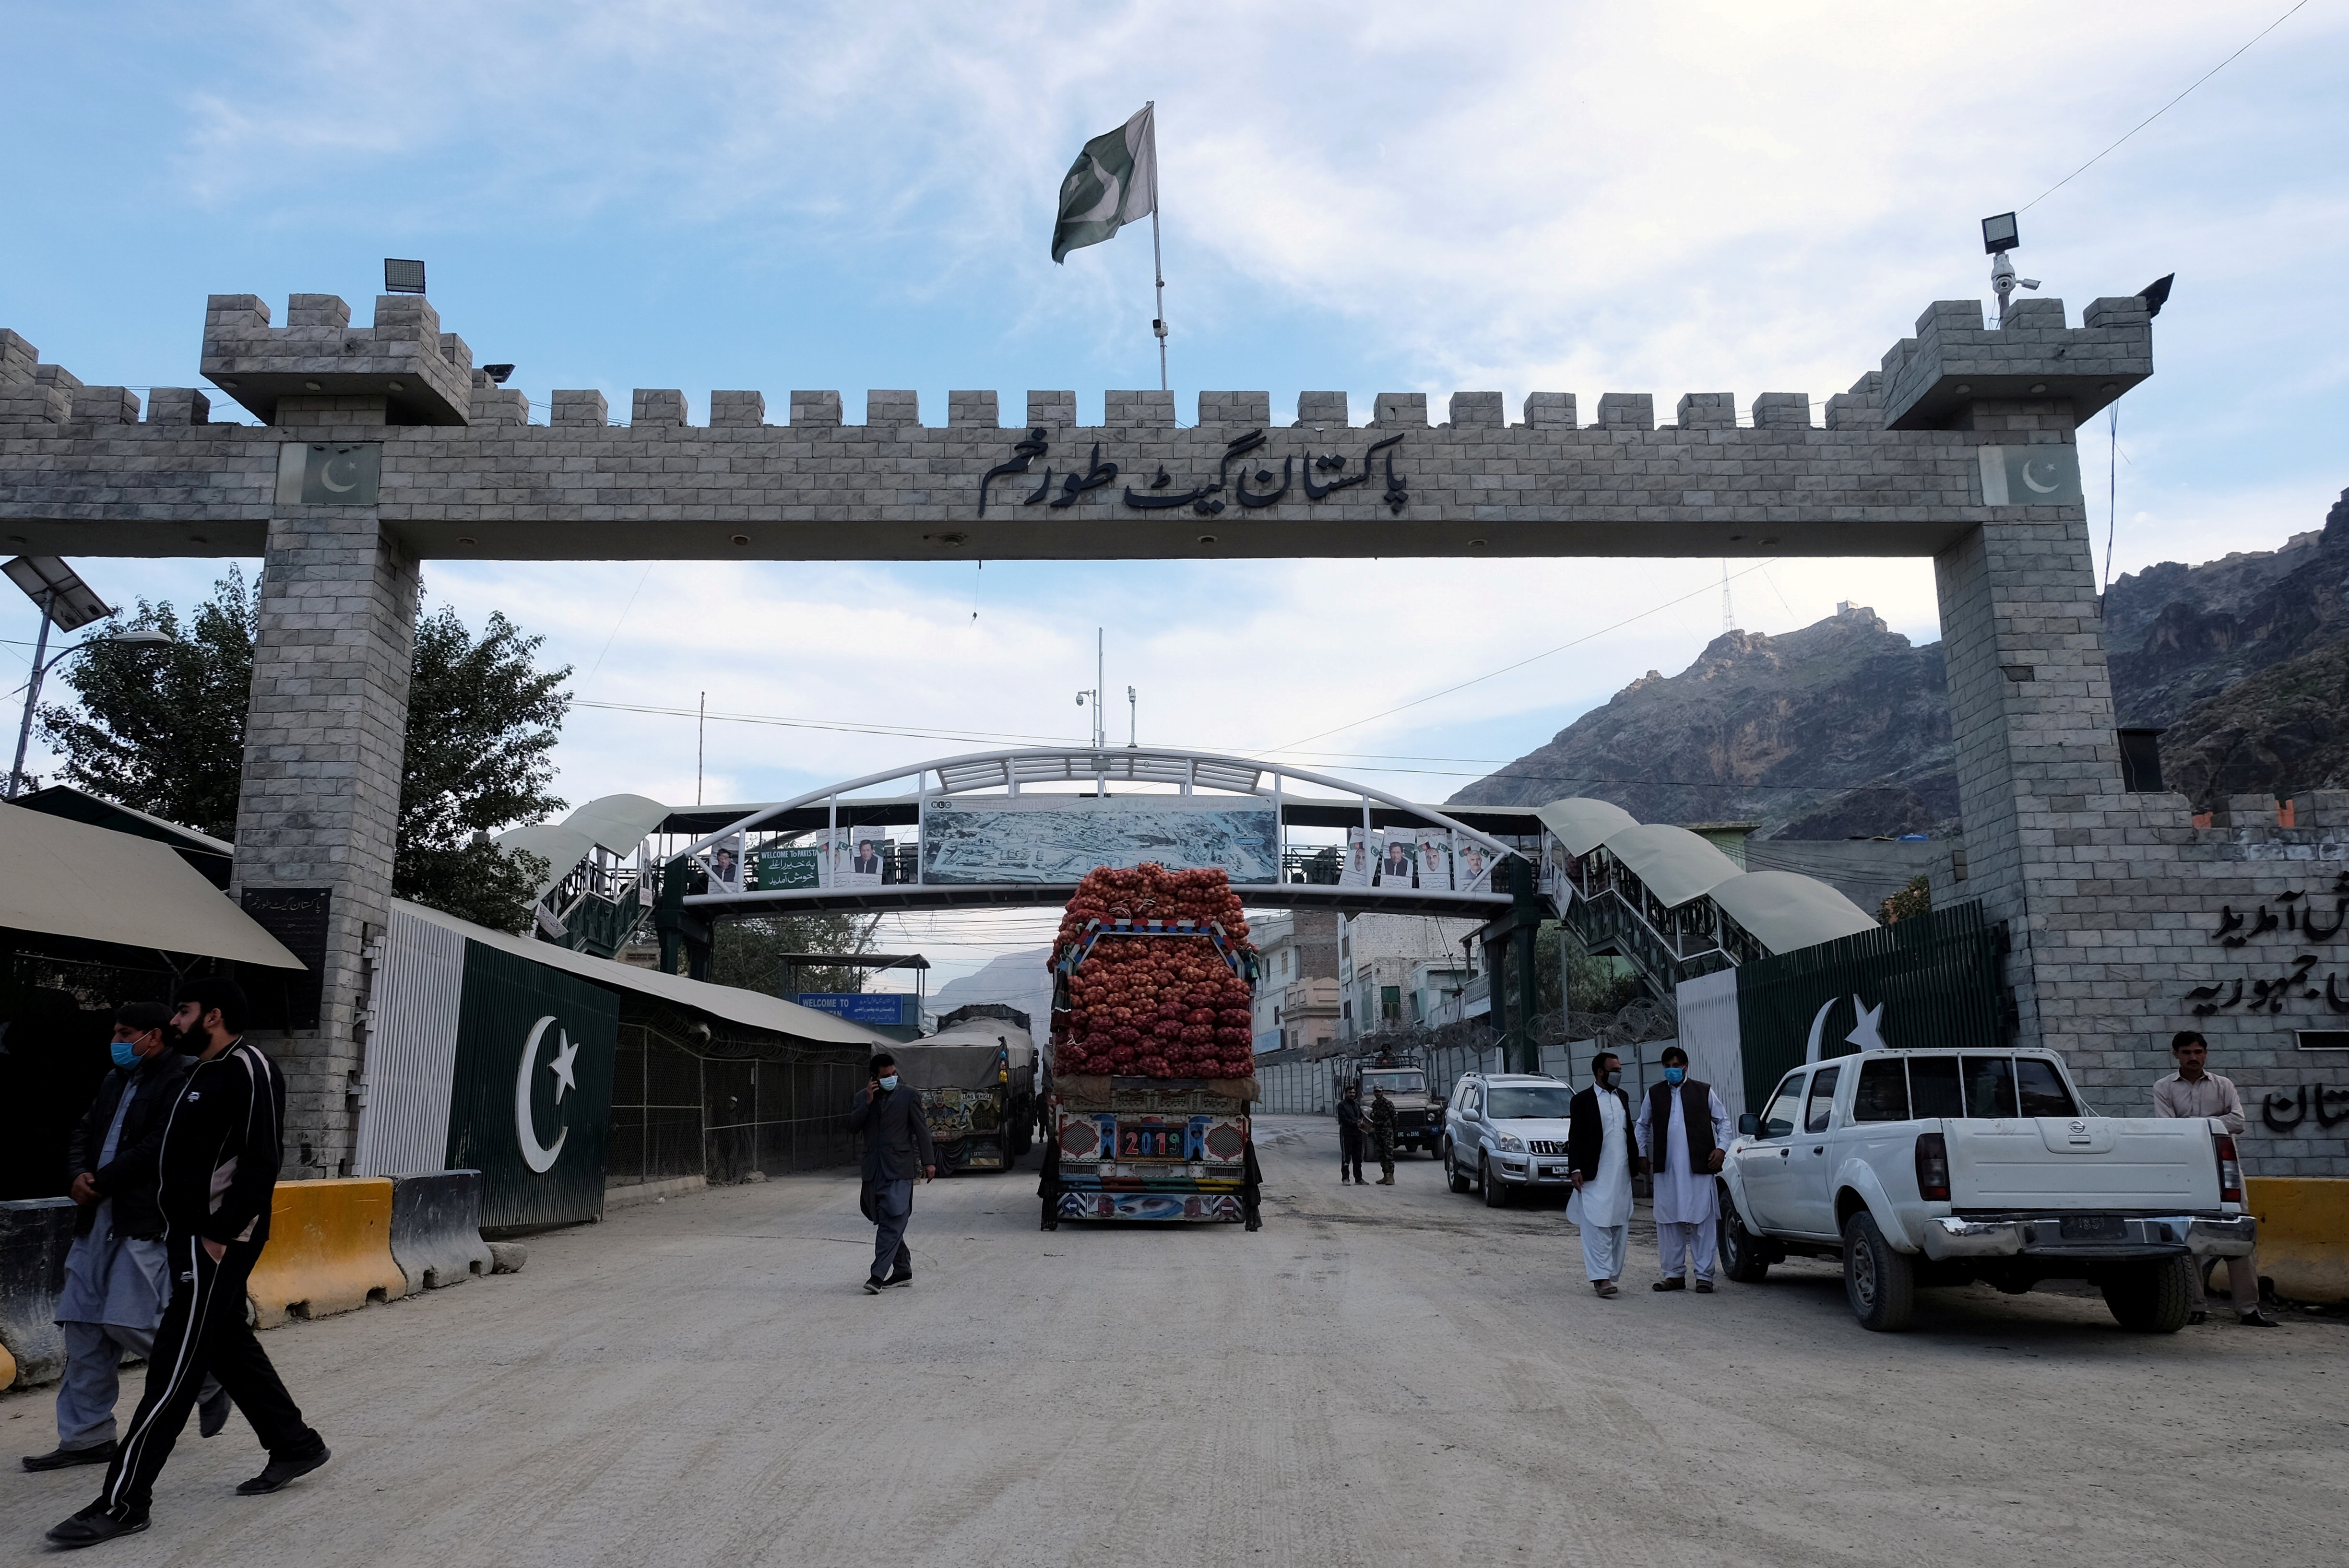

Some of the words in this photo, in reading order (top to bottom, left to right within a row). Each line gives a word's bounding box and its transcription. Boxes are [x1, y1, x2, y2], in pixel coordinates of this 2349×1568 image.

[1124, 428, 1267, 515] گیٹ
[1236, 432, 1409, 514] پاکستان
[1044, 801, 1065, 810] MAP
[761, 850, 788, 859] WELCOME
[769, 872, 789, 886] آمدید
[787, 872, 815, 883] خوش
[270, 896, 296, 910] گیٹ
[290, 897, 321, 914] پاکستان
[2211, 889, 2305, 946] آمدید
[803, 999, 837, 1007] WELCOME
[840, 999, 849, 1007] TO
[1125, 1132, 1180, 1155] 2019
